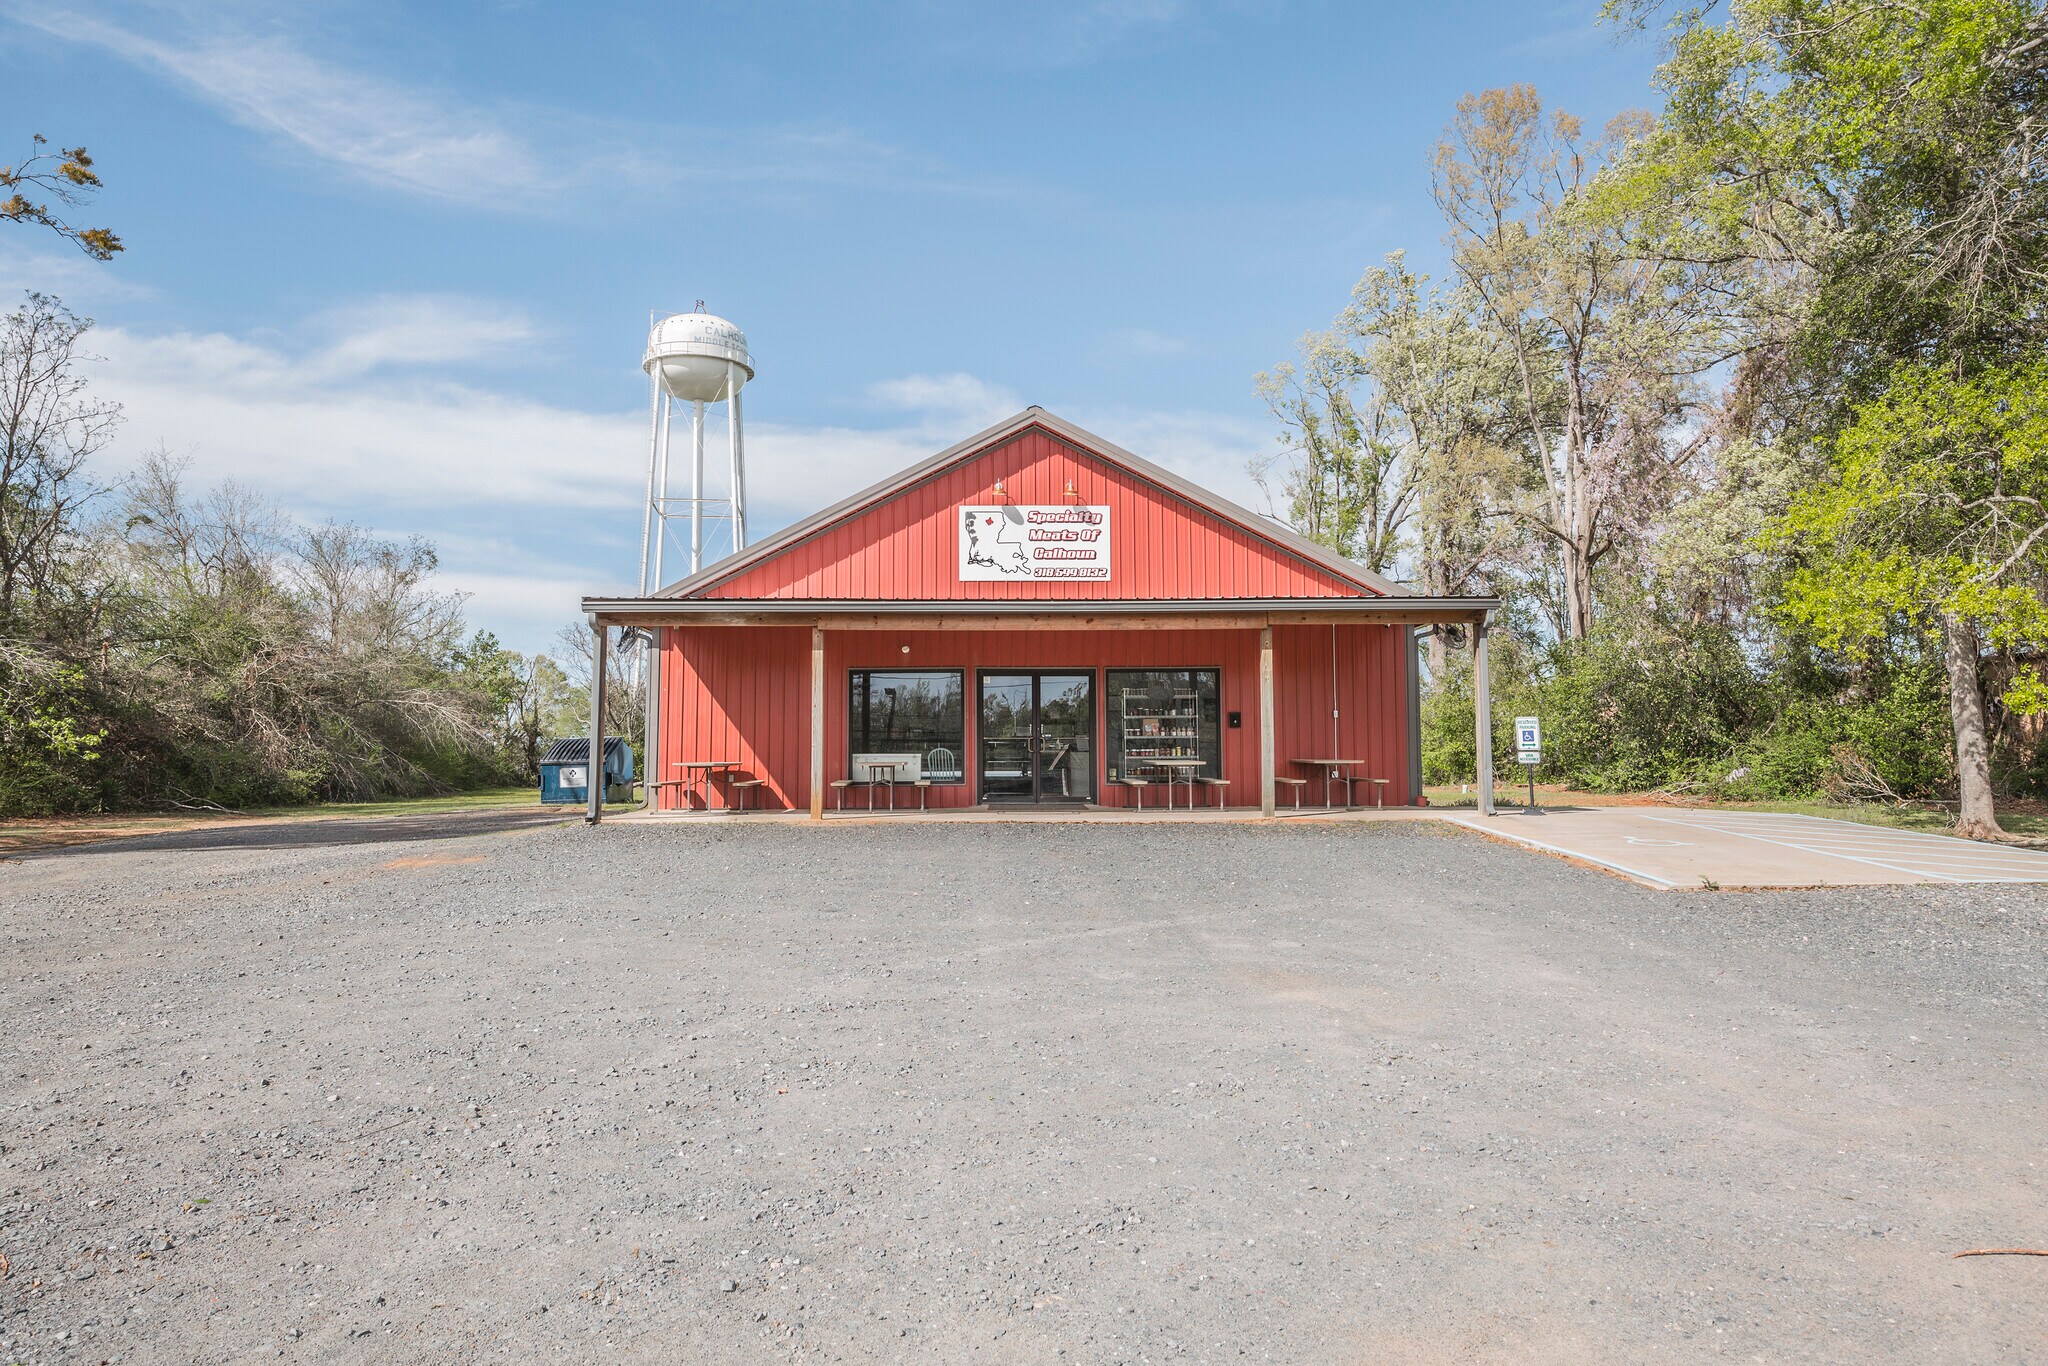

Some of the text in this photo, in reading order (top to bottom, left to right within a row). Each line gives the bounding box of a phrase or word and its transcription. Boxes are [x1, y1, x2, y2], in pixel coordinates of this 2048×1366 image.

[694, 335, 730, 348] MIDDLE
[1027, 510, 1103, 524] Specialty
[1028, 529, 1102, 542] Meats Of
[1033, 548, 1097, 559] Calhoun
[1034, 568, 1108, 577] 318.599.8132
